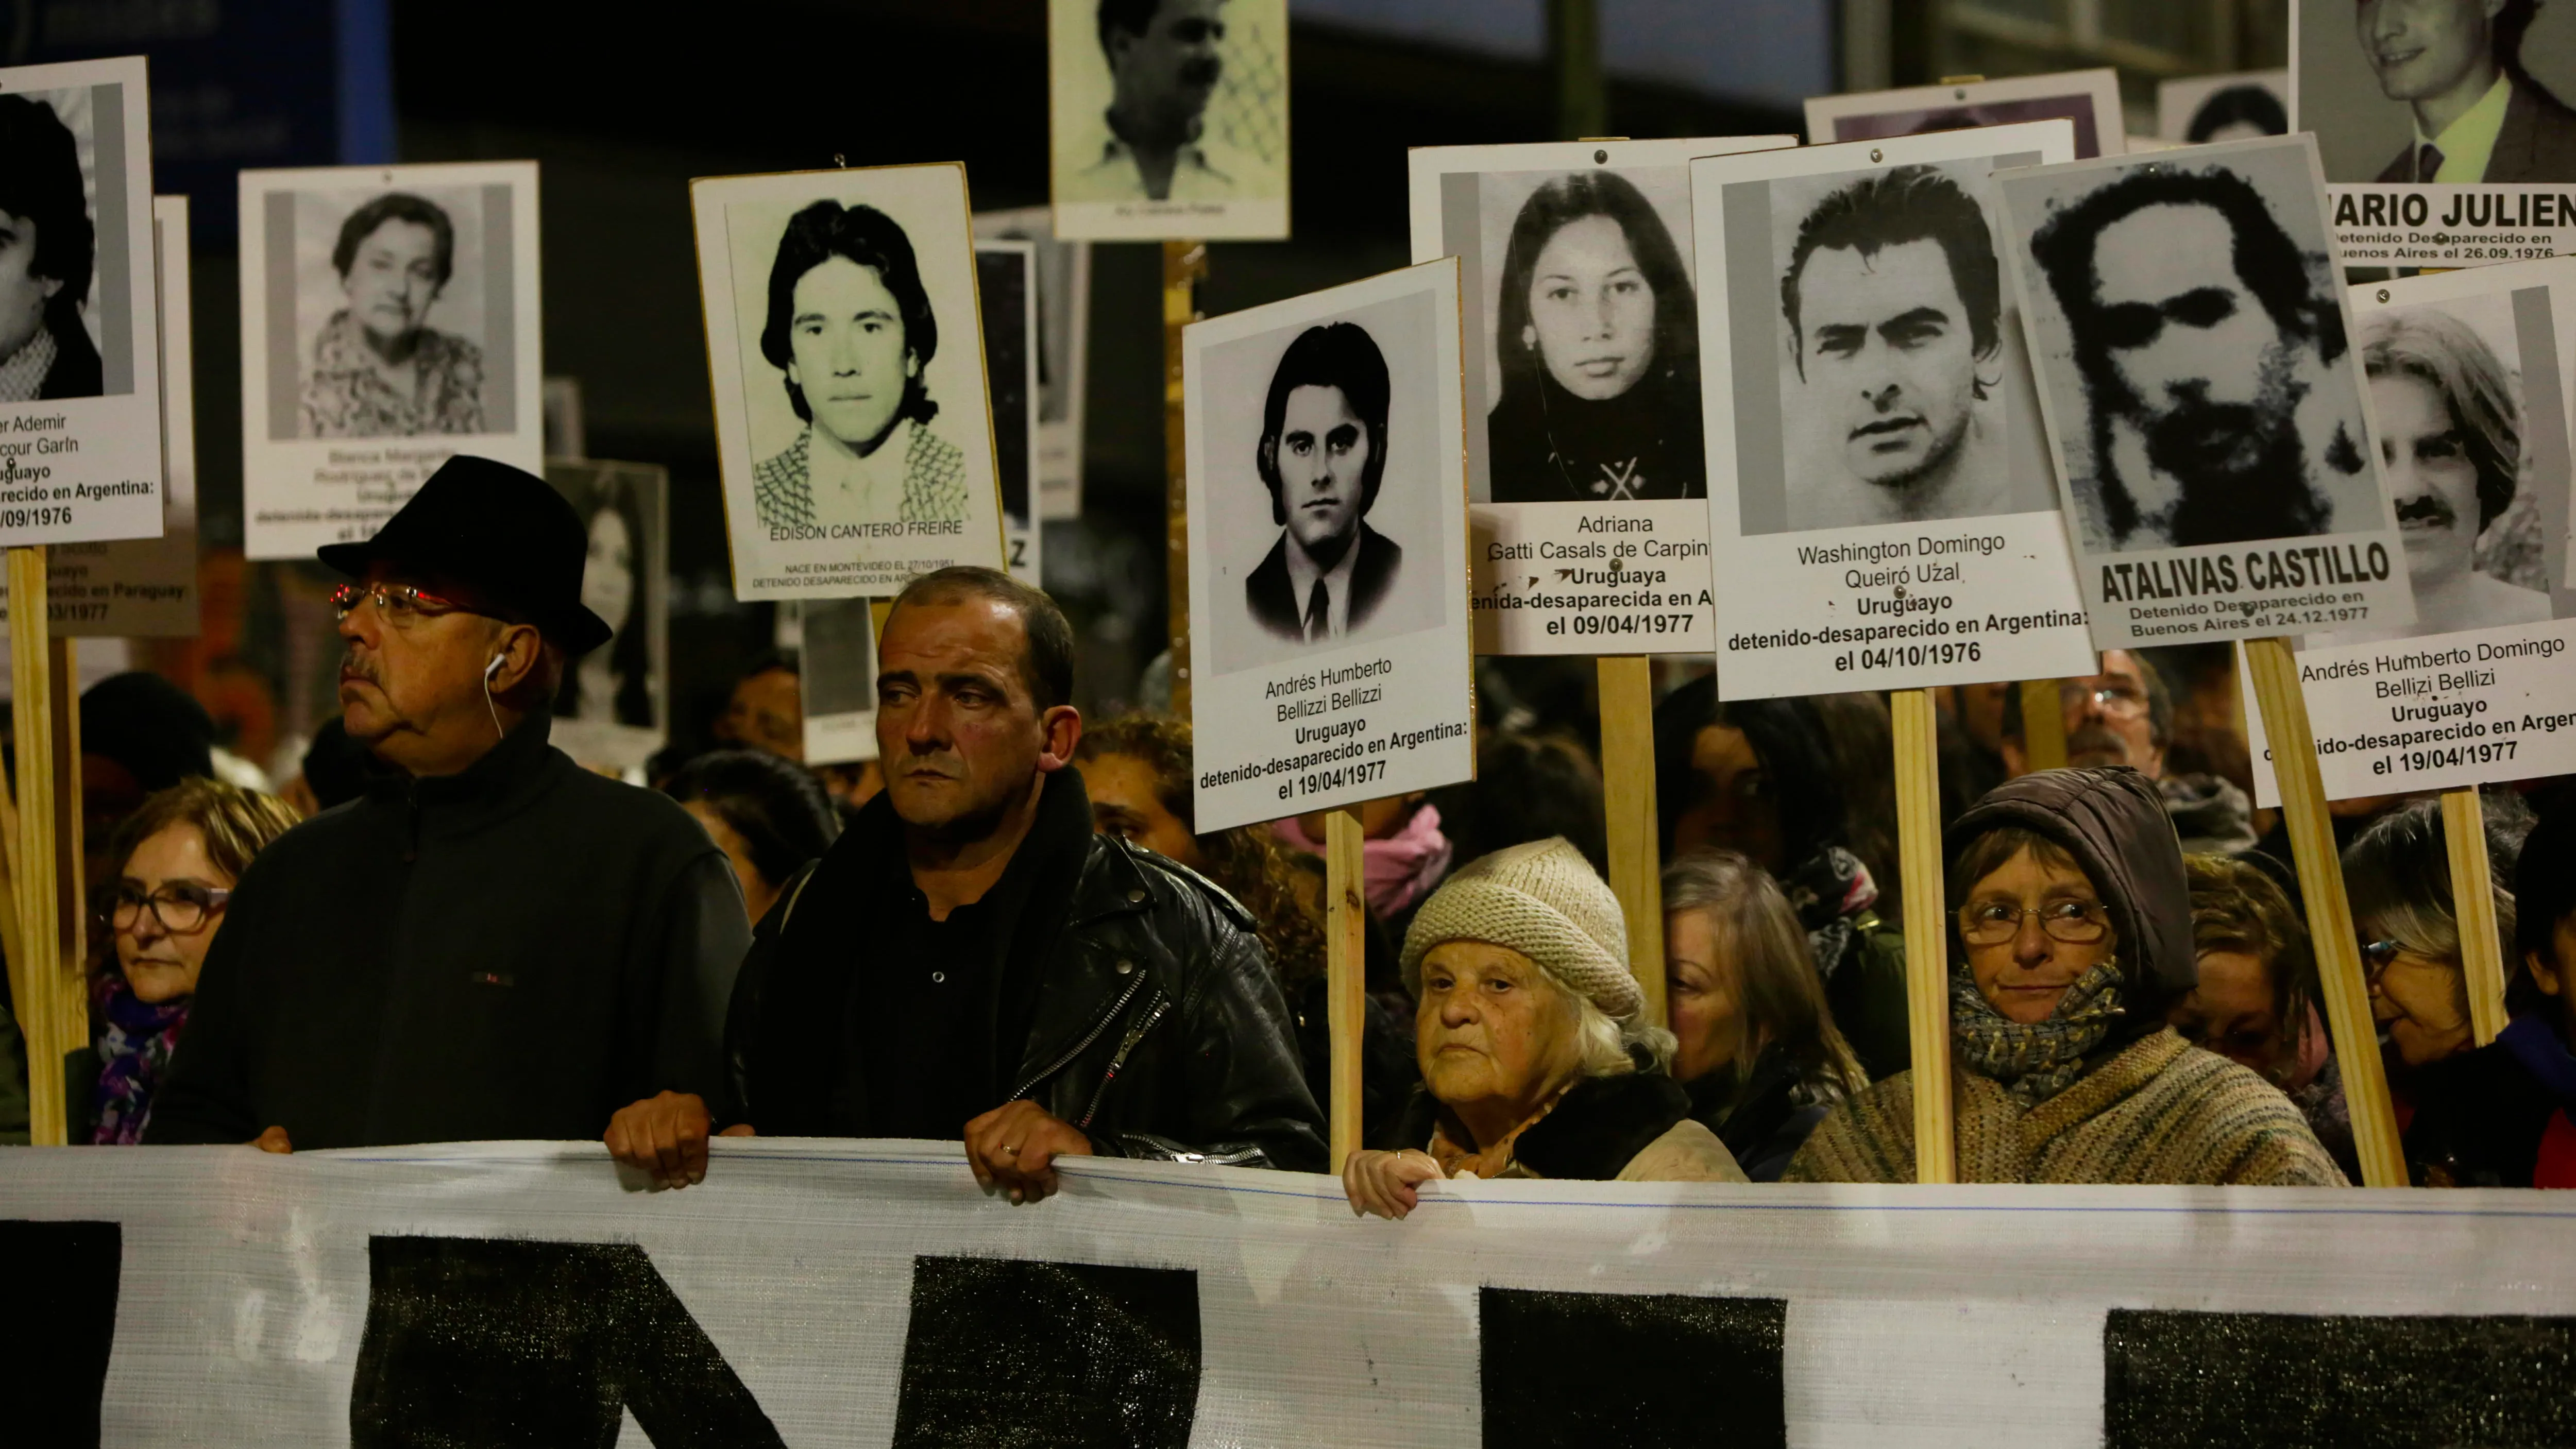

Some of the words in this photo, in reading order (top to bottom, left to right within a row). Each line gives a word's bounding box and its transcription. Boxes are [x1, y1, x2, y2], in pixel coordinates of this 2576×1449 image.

[2328, 194, 2428, 227] ARIO
[2336, 232, 2402, 243] etenido
[2531, 235, 2551, 244] en
[2394, 248, 2438, 258] Aires
[2444, 248, 2458, 258] el
[2464, 248, 2554, 258] 26.09.1976
[13, 413, 66, 432] Ademir
[37, 436, 78, 454] Garín
[0, 487, 48, 502] recido
[53, 487, 71, 500] en
[75, 480, 154, 501] Argentina:
[770, 525, 825, 541] EDISON
[831, 523, 903, 539] CANTERO
[908, 520, 962, 536] FREIRE
[1578, 516, 1653, 534] Adriana
[1488, 542, 1533, 560] Gatti
[1540, 541, 1606, 559] Casals
[1614, 541, 1637, 558] de
[1644, 539, 1710, 560] Carpin
[1798, 540, 1910, 565] Washington
[1918, 534, 2005, 556] Domingo
[786, 565, 810, 574] NACE
[814, 564, 825, 573] EN
[828, 561, 892, 572] MONTEVIDEO
[894, 560, 905, 570] EL
[1571, 568, 1666, 588] Uruguaya
[1846, 566, 1909, 588] Queiró
[1917, 562, 1959, 583] Uzal
[2102, 554, 2238, 603] ATALIVAS
[2245, 542, 2389, 591] CASTILLO
[753, 577, 800, 588] DETENIDO
[803, 574, 876, 586] DESAPARECIDO
[879, 574, 894, 583] EN
[1669, 594, 1691, 606] en
[1857, 596, 1952, 617] Uruguayo
[2129, 602, 2208, 620] Detenido
[2343, 591, 2364, 603] en
[1547, 617, 1565, 635] el
[1573, 615, 1693, 635] 09/04/1977
[1728, 619, 1950, 651] detenido-desaparecido
[1956, 619, 1979, 634] en
[1986, 609, 2089, 634] Argentina:
[2130, 622, 2199, 638] Buenos
[2204, 618, 2250, 632] Aires
[2256, 615, 2270, 626] el
[2277, 607, 2368, 625] 24.12.1977
[1835, 651, 1853, 671] el
[1861, 642, 1981, 669] 04/10/1976
[2302, 660, 2369, 682] Andrés
[2376, 647, 2471, 673] Humberto
[2477, 639, 2565, 661] Domingo
[1266, 674, 1316, 699] Andrés
[1320, 658, 1392, 688] Humberto
[2376, 678, 2432, 698] Bellizi
[2440, 668, 2495, 692] Bellizi
[1278, 696, 1327, 722] Bellizzi
[1332, 684, 1381, 711] Bellizzi
[2392, 700, 2487, 722] Uruguayo
[1296, 719, 1366, 744] Uruguayo
[2493, 721, 2515, 734] en
[1200, 741, 1363, 789] detenido-desaparecido
[1368, 738, 1385, 753] en
[1390, 721, 1467, 750] Argentina:
[2372, 756, 2392, 775] el
[2400, 741, 2518, 772] 19/04/1977
[1279, 780, 1292, 800] el
[1299, 760, 1386, 795] 19/04/1977
